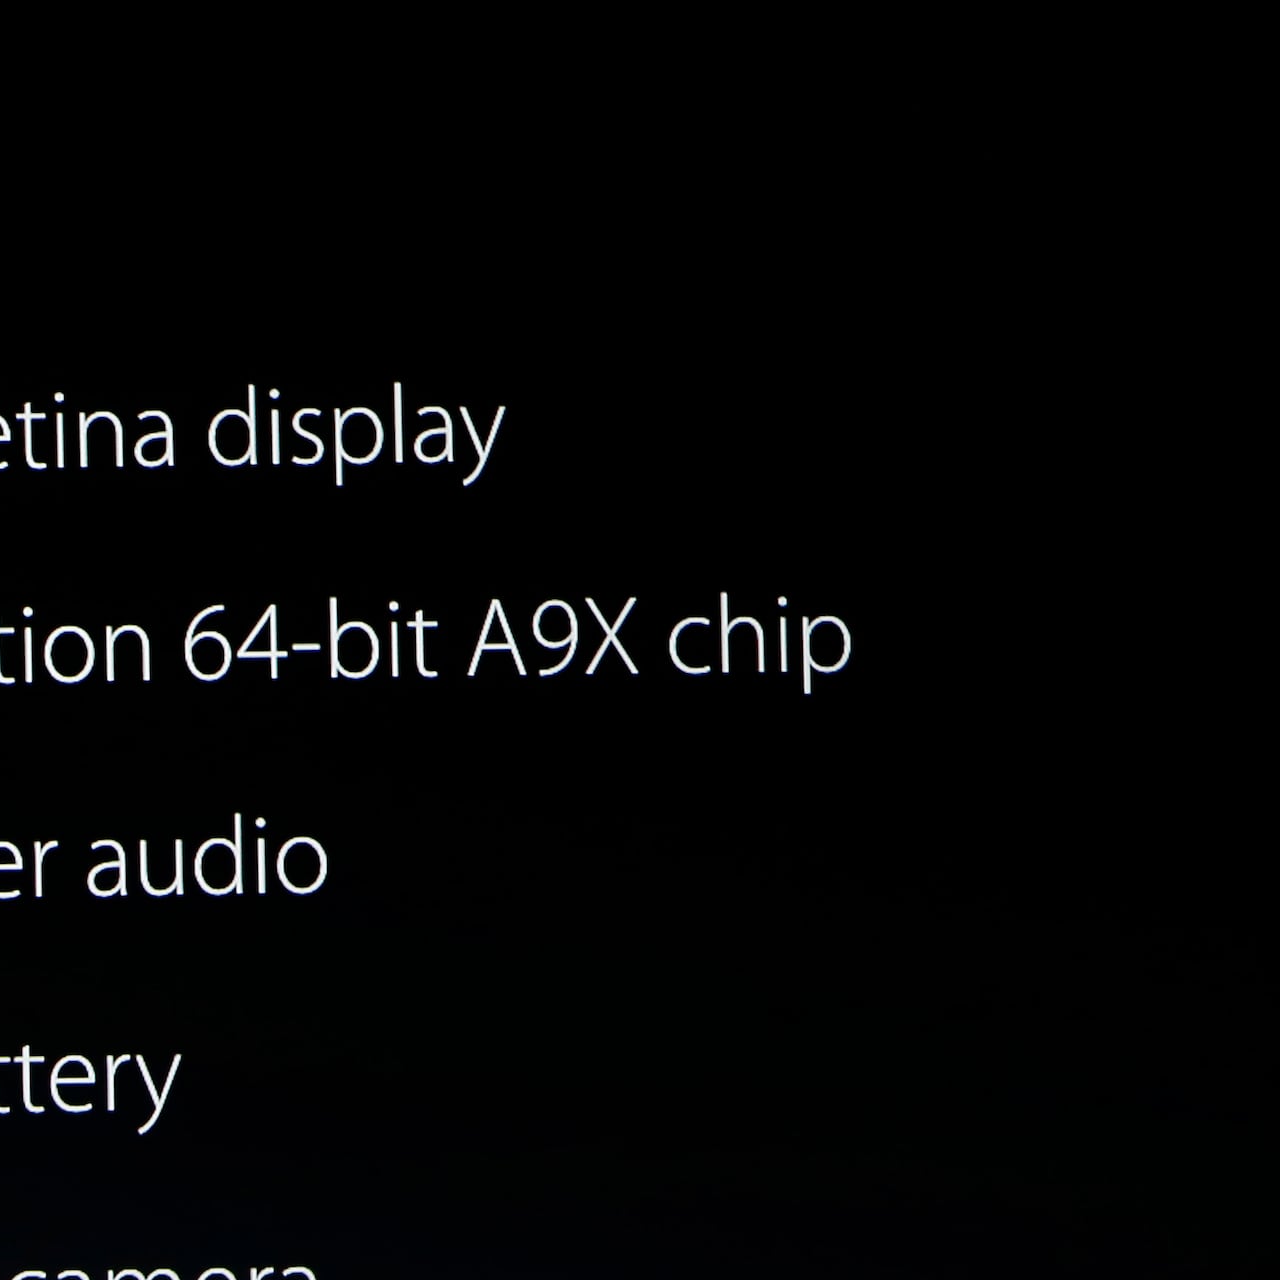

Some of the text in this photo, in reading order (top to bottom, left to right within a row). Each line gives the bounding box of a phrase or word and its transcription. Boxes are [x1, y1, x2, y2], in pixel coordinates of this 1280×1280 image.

[207, 381, 506, 487] display
[184, 596, 439, 682] 64-bit
[466, 596, 639, 677] A9X
[668, 591, 852, 695] chip
[86, 812, 328, 899] audio
